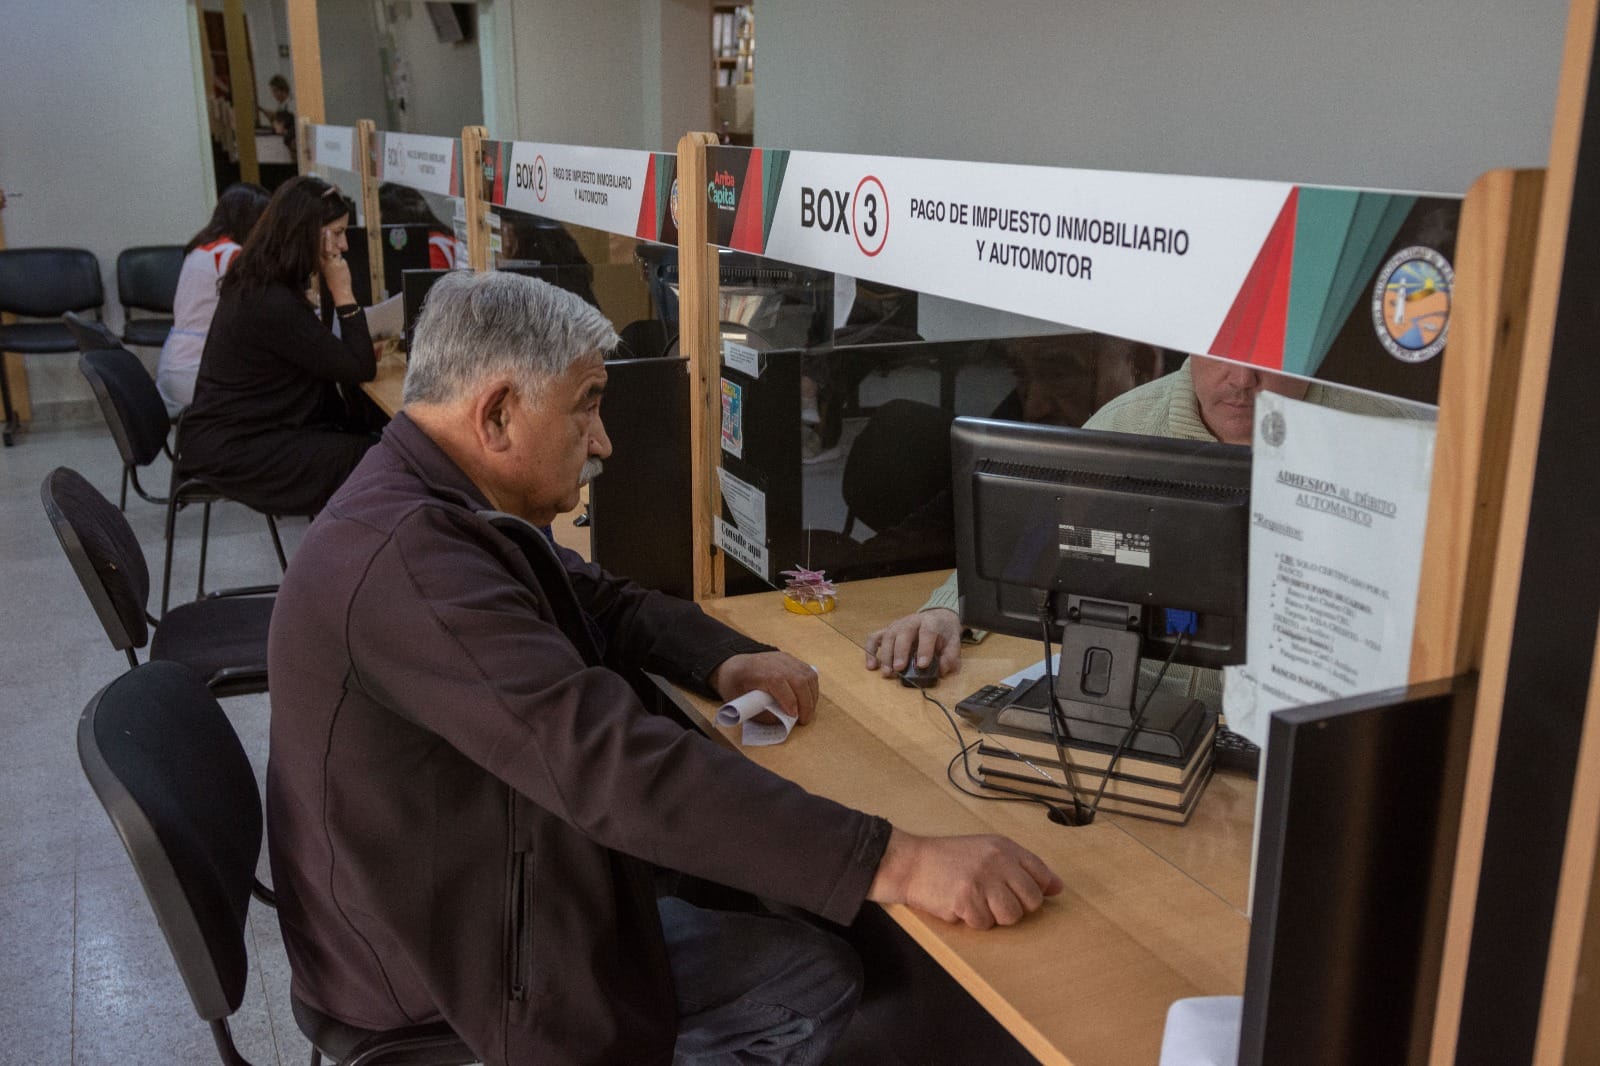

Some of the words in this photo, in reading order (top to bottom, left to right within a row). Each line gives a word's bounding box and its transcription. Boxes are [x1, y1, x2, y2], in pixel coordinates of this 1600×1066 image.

[516, 163, 534, 190] BOX
[537, 166, 543, 191] 2
[553, 168, 565, 180] PAGO
[565, 170, 572, 182] DE
[571, 171, 596, 185] IMPUESTO
[596, 173, 632, 191] INMOBILIARIO
[714, 170, 735, 187] Arriba
[578, 190, 608, 206] AUTOMOTOR
[708, 181, 735, 209] Capital
[801, 186, 850, 235] BOX
[863, 193, 878, 238] 3
[910, 198, 946, 222] PAGO
[949, 202, 969, 226] DE
[972, 205, 1051, 237] IMPUESTO
[1056, 215, 1190, 256] INMOBILIARIO
[976, 239, 986, 261] Y
[989, 242, 1093, 280] AUTOMOTOR
[1277, 469, 1337, 496] ADHESION
[1340, 487, 1351, 501] AL
[721, 522, 747, 547] Consulte
